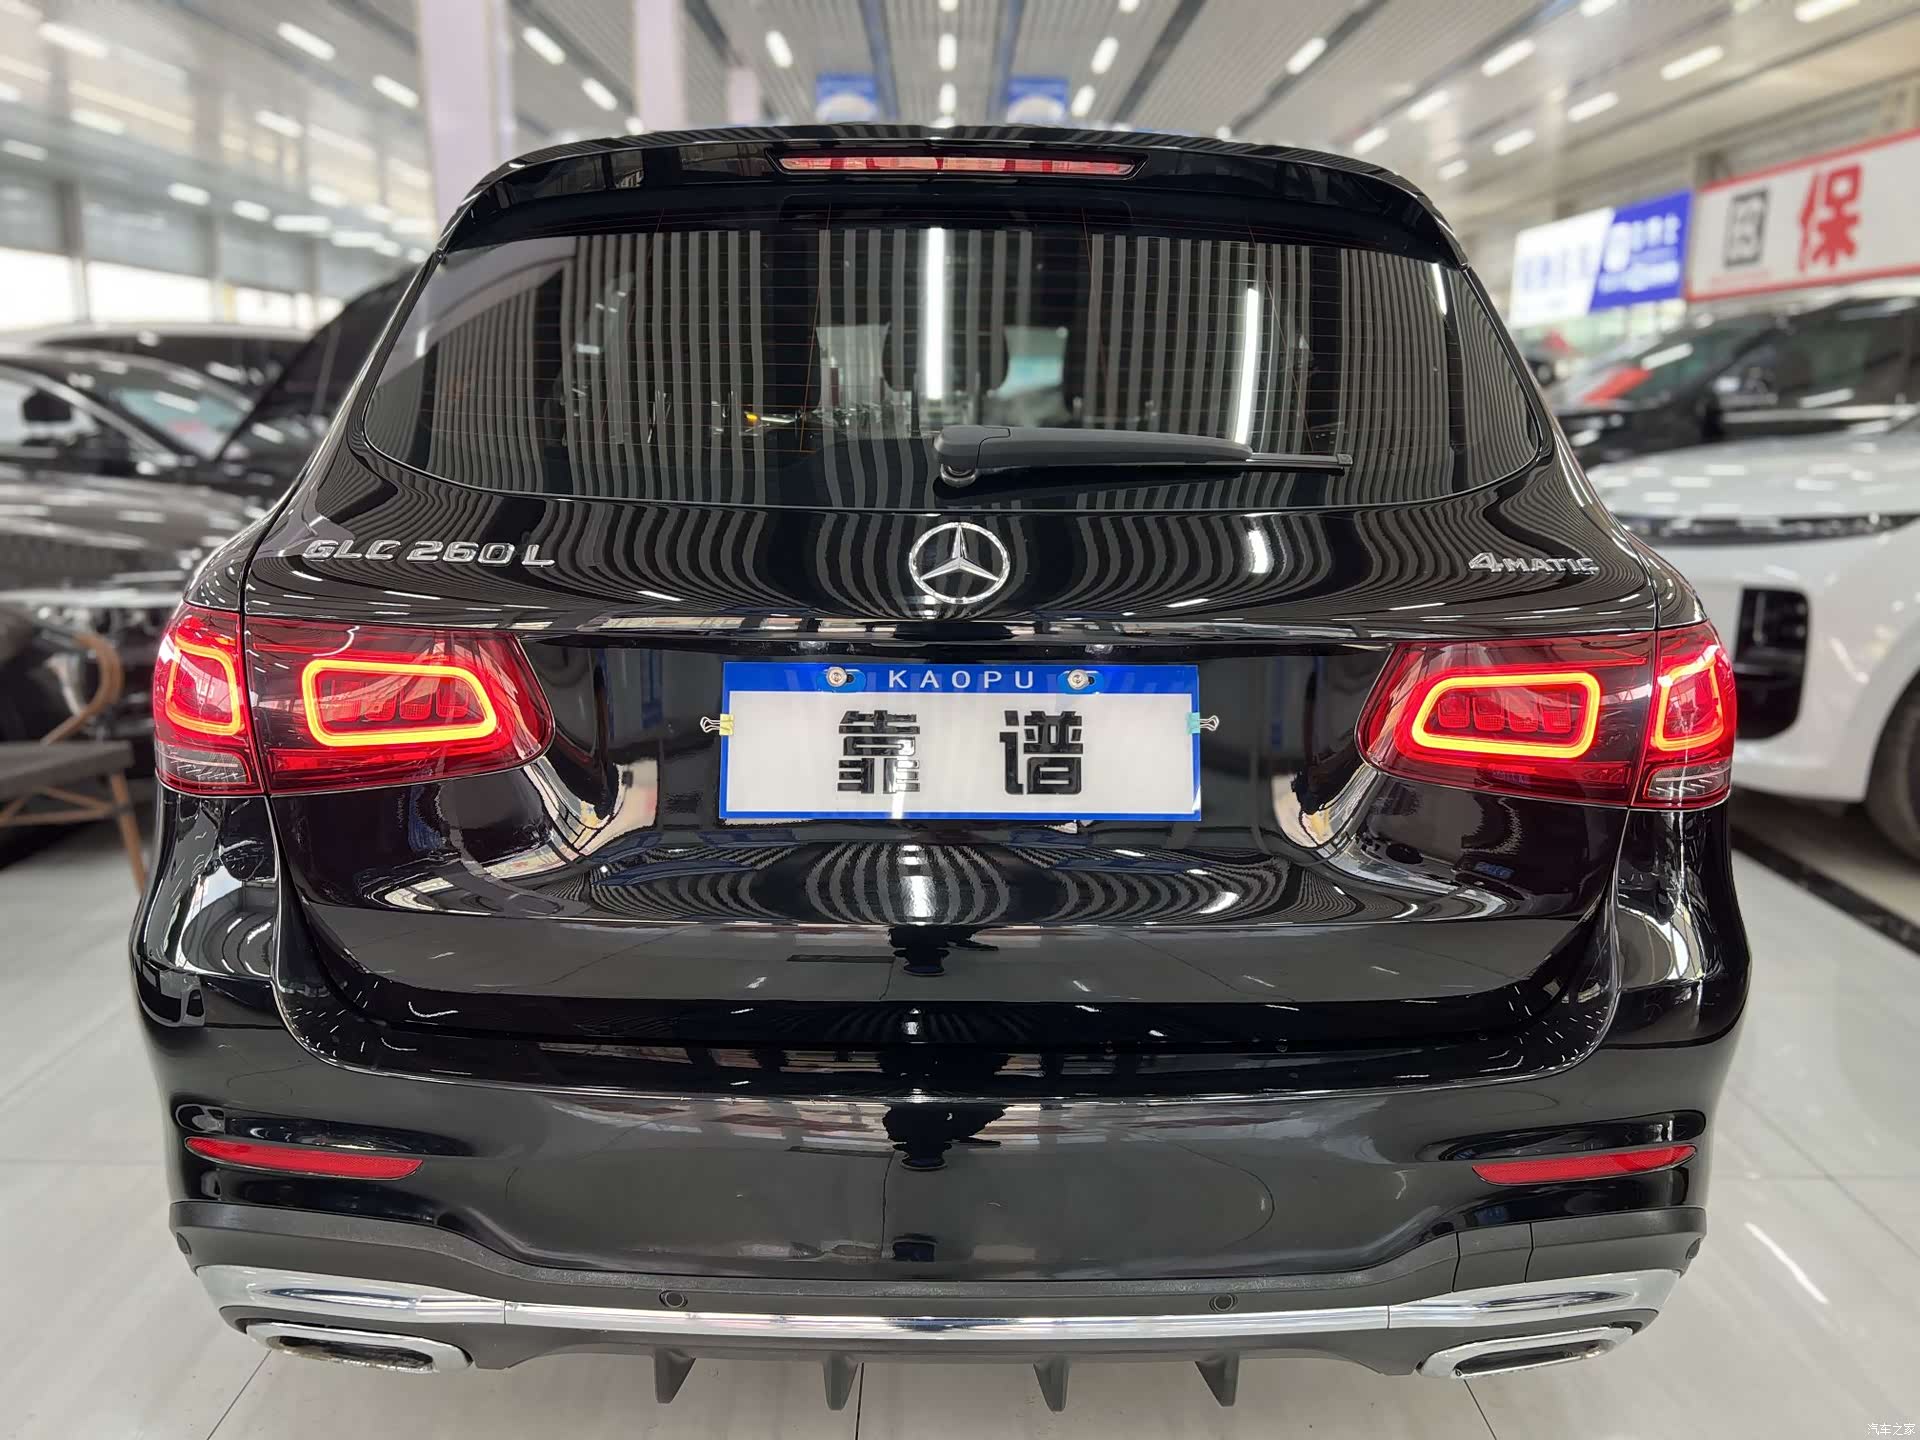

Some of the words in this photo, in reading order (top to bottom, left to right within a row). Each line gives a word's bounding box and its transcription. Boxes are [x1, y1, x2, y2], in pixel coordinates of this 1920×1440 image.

[302, 540, 401, 560] GLC
[406, 541, 515, 564] 260
[521, 544, 555, 566] L
[1468, 552, 1600, 574] 4MATIC
[888, 670, 1035, 690] KAOPU
